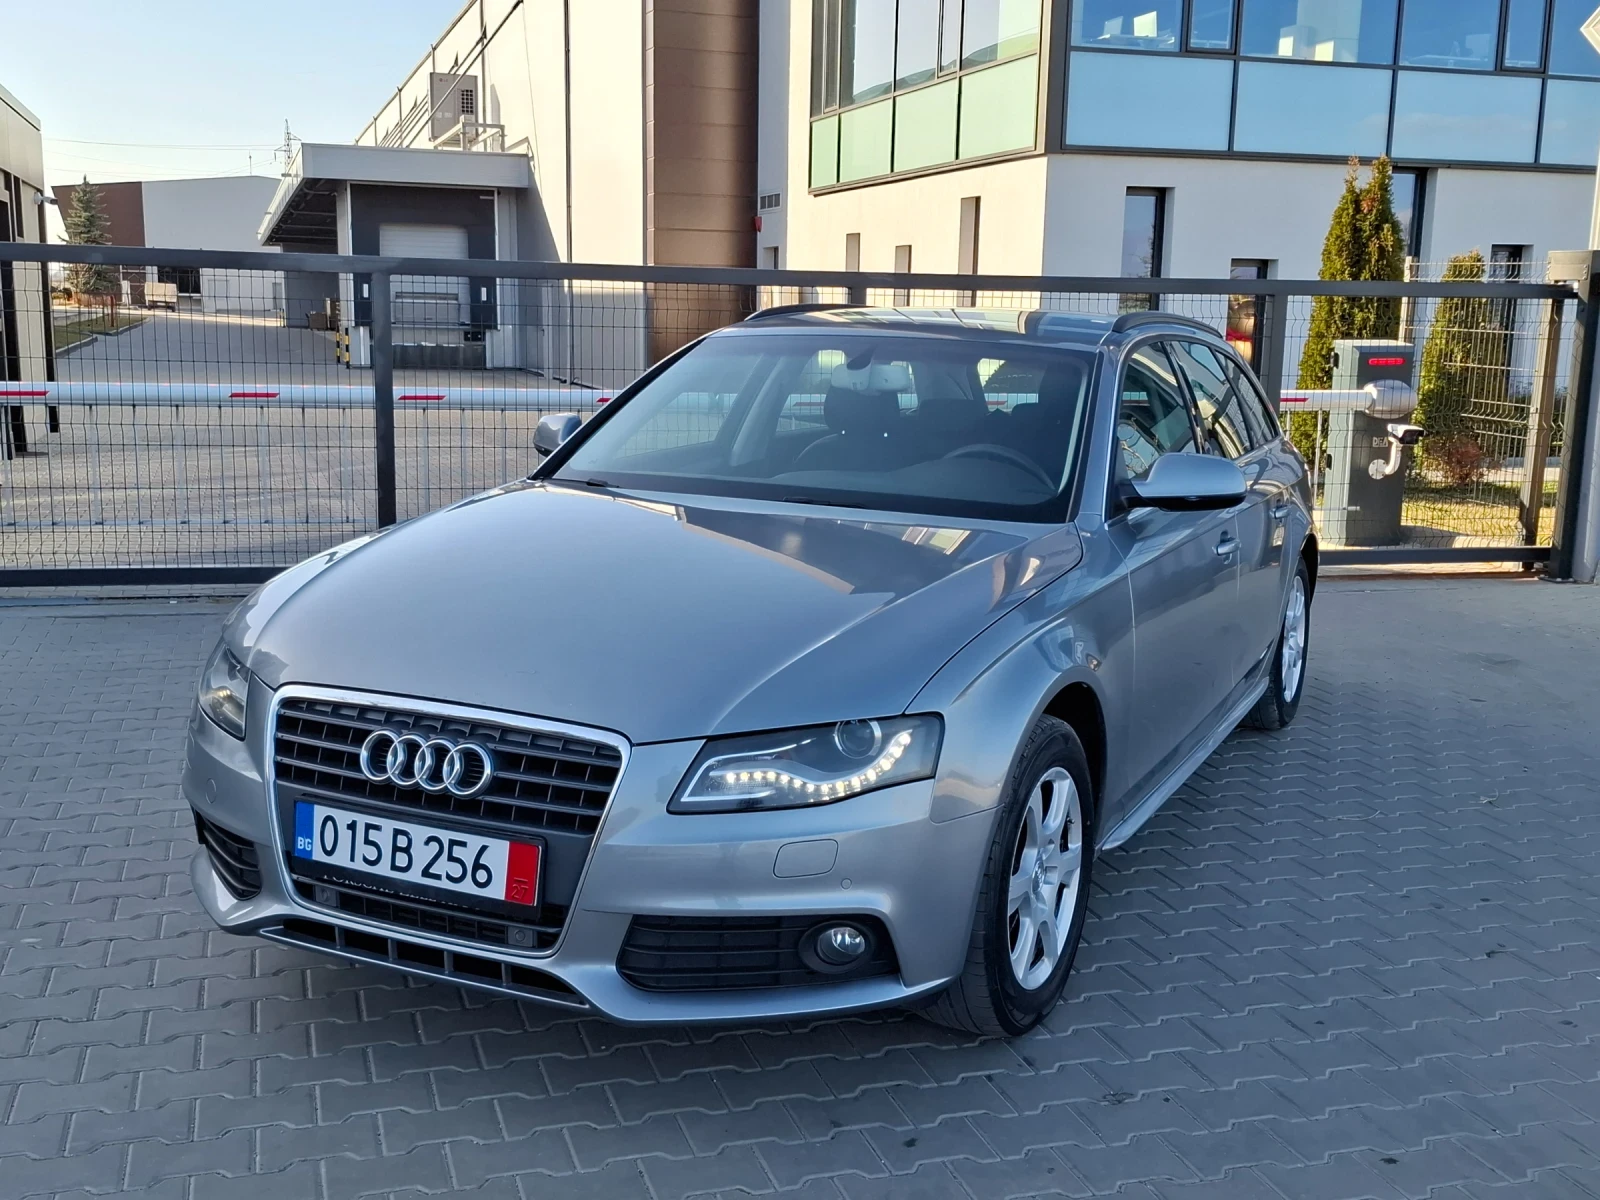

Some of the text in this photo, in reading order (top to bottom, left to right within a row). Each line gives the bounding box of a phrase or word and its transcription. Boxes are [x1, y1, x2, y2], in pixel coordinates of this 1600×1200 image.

[1372, 436, 1389, 448] DEA
[297, 836, 312, 851] BG
[319, 814, 493, 889] 015B256
[511, 883, 530, 899] 27
